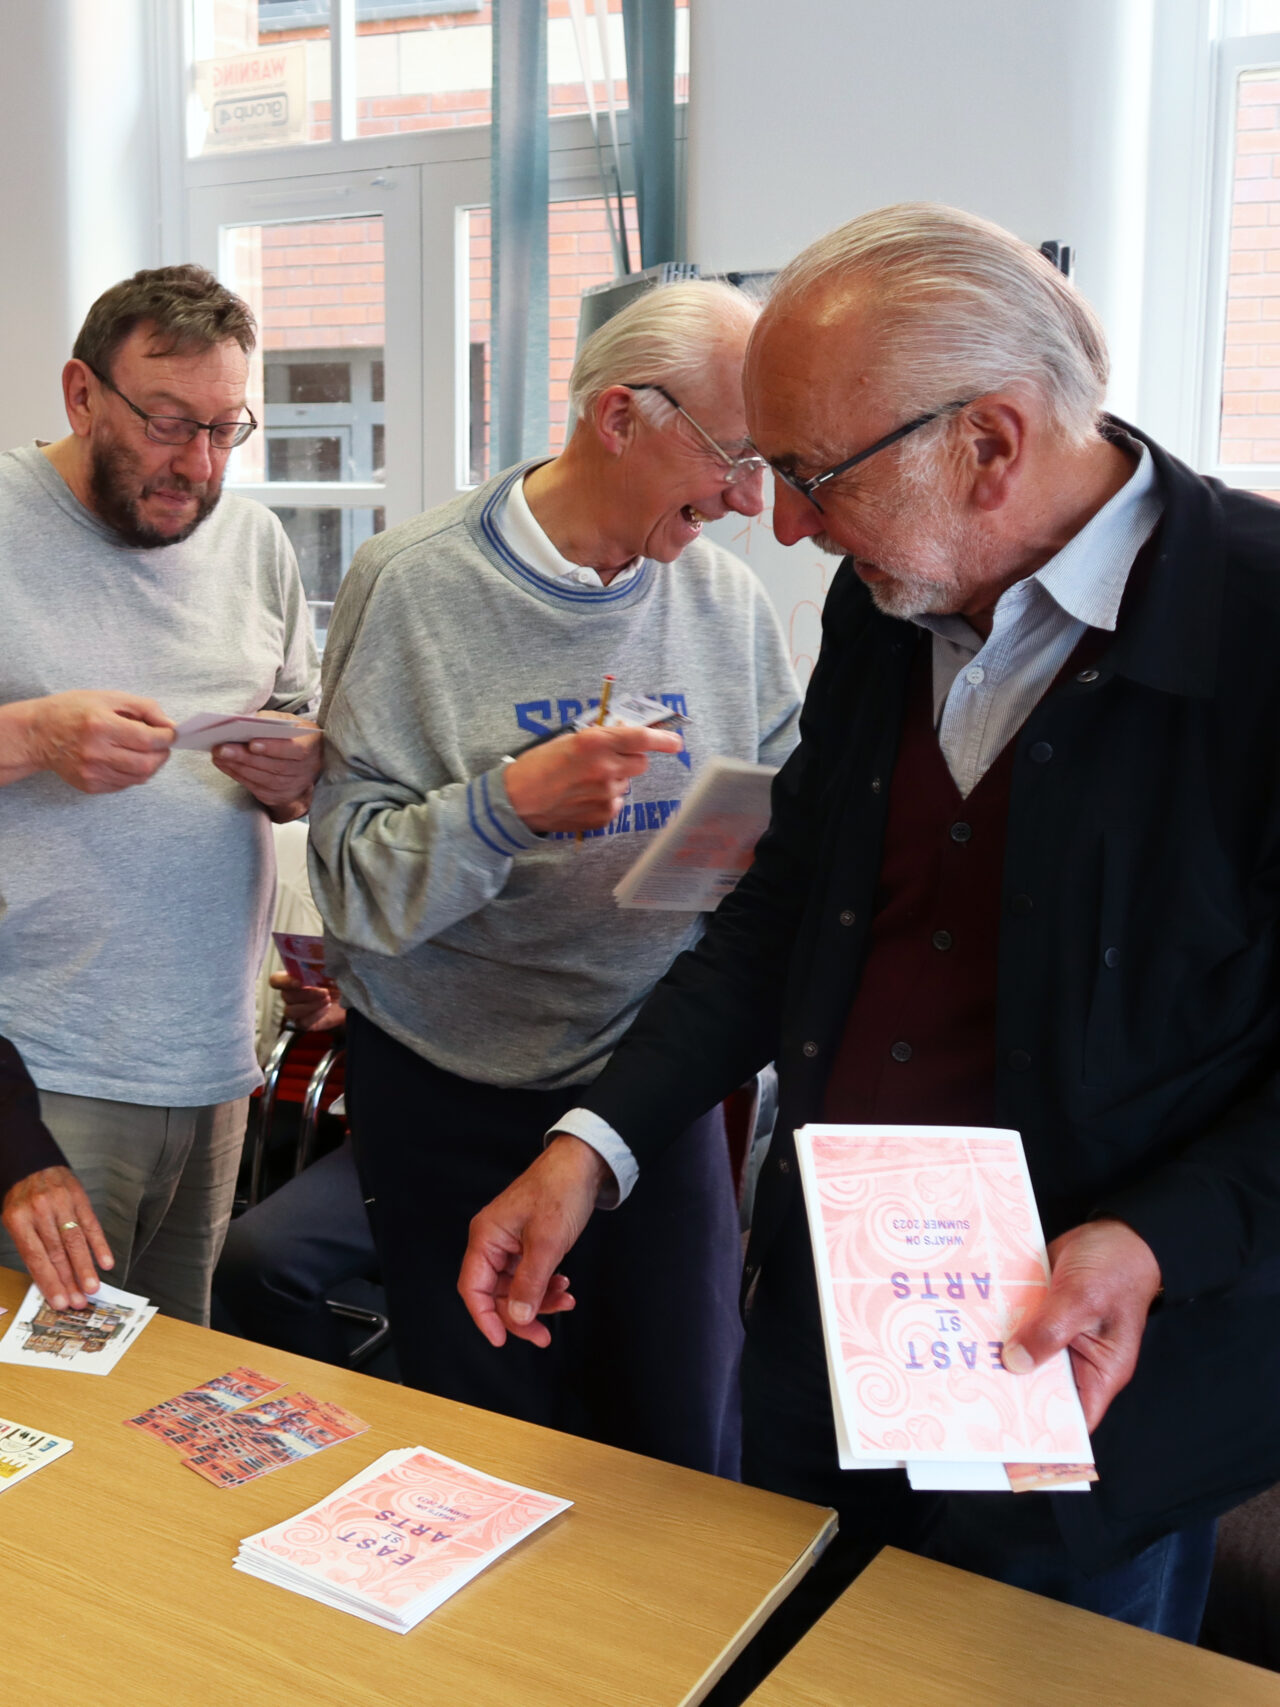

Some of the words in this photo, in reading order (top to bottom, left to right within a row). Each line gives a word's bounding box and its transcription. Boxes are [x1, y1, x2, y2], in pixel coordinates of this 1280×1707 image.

[892, 1219, 920, 1230] 2023
[924, 1219, 970, 1230] SUMMER
[906, 1235, 920, 1246] ON
[924, 1235, 964, 1246] WHAT'S
[891, 1271, 991, 1300] ARTS
[938, 1316, 962, 1332] ST
[905, 1341, 1006, 1370] EAST
[375, 1510, 452, 1542] ARTS
[381, 1533, 402, 1544] ST
[336, 1531, 416, 1566] EAST
